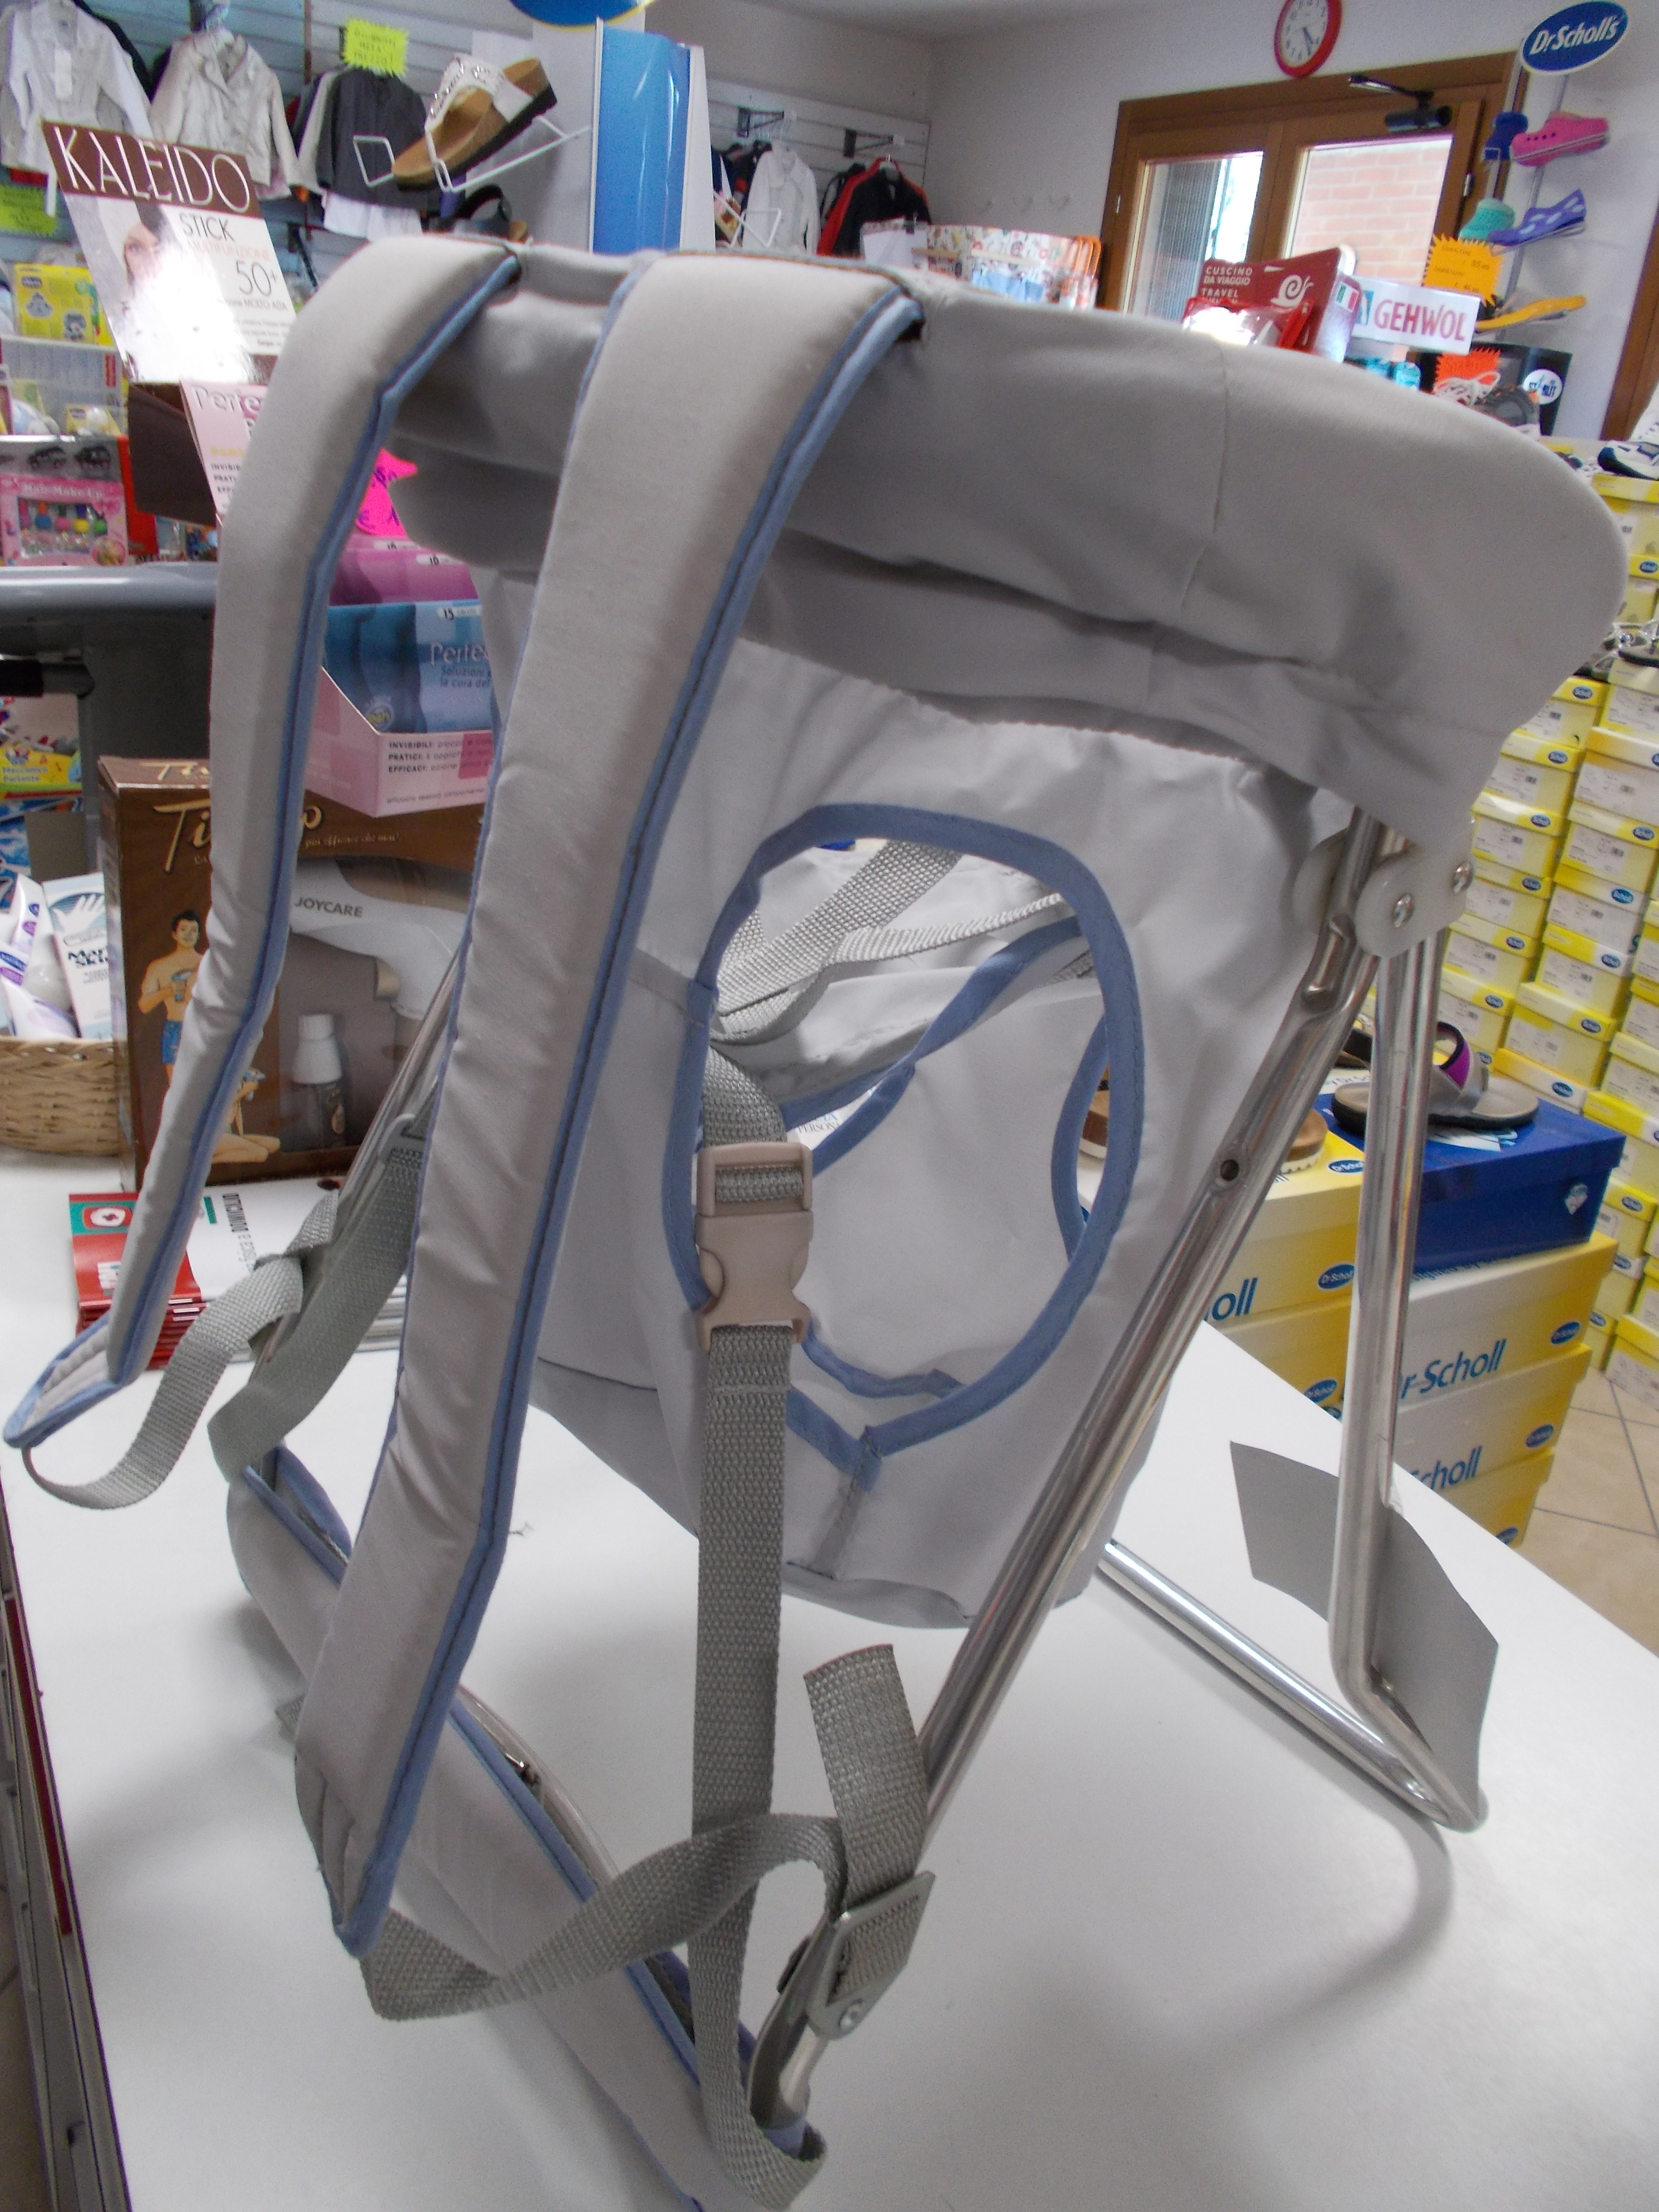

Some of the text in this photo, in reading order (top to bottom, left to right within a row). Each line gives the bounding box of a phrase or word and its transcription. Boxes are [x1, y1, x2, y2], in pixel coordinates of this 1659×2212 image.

[54, 125, 250, 213] KALEIDO
[179, 212, 235, 242] STICK
[1203, 276, 1250, 286] DA VIAGGIO
[1205, 266, 1253, 276] CUSCINO
[1202, 288, 1238, 298] TRAVEL
[1373, 299, 1467, 341] GEHWOL
[295, 897, 363, 918] JOYCARE
